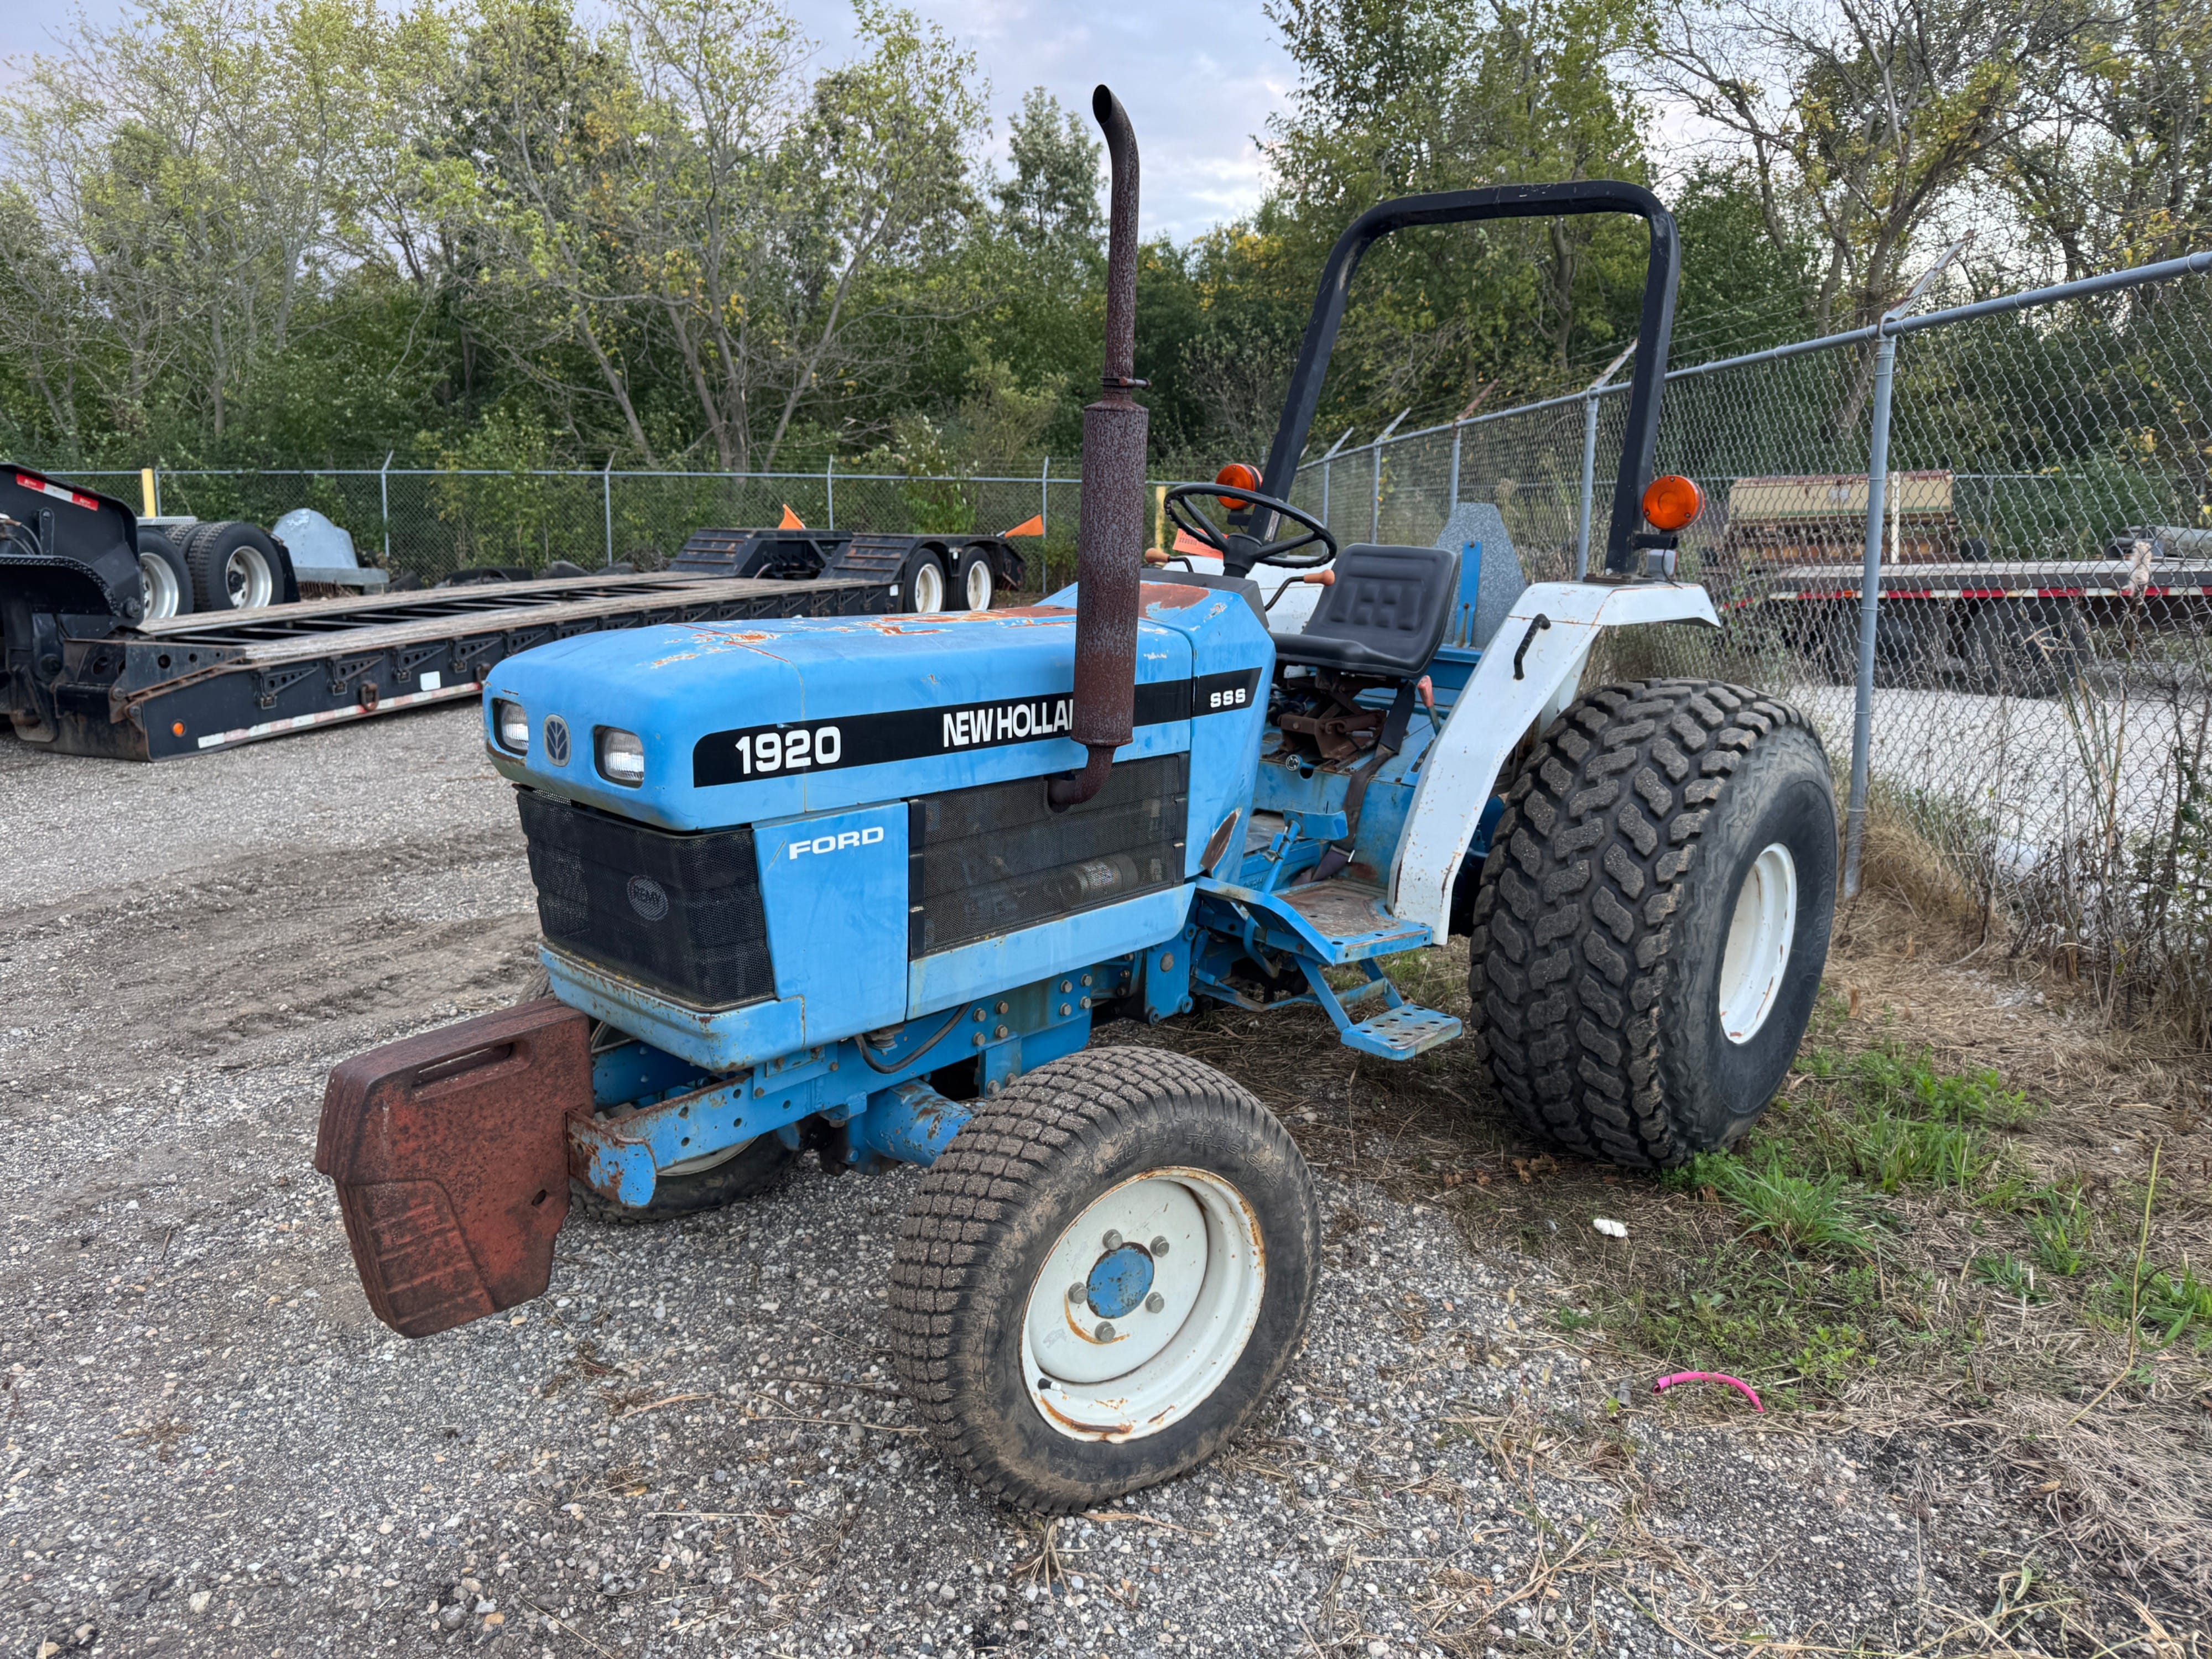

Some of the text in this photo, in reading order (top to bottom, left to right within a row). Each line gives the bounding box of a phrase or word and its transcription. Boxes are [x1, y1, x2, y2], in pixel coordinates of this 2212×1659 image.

[1210, 688, 1246, 708] SSS
[943, 699, 1073, 747] NEW HOLLA
[735, 726, 841, 774] 1920
[789, 827, 884, 860] FORD
